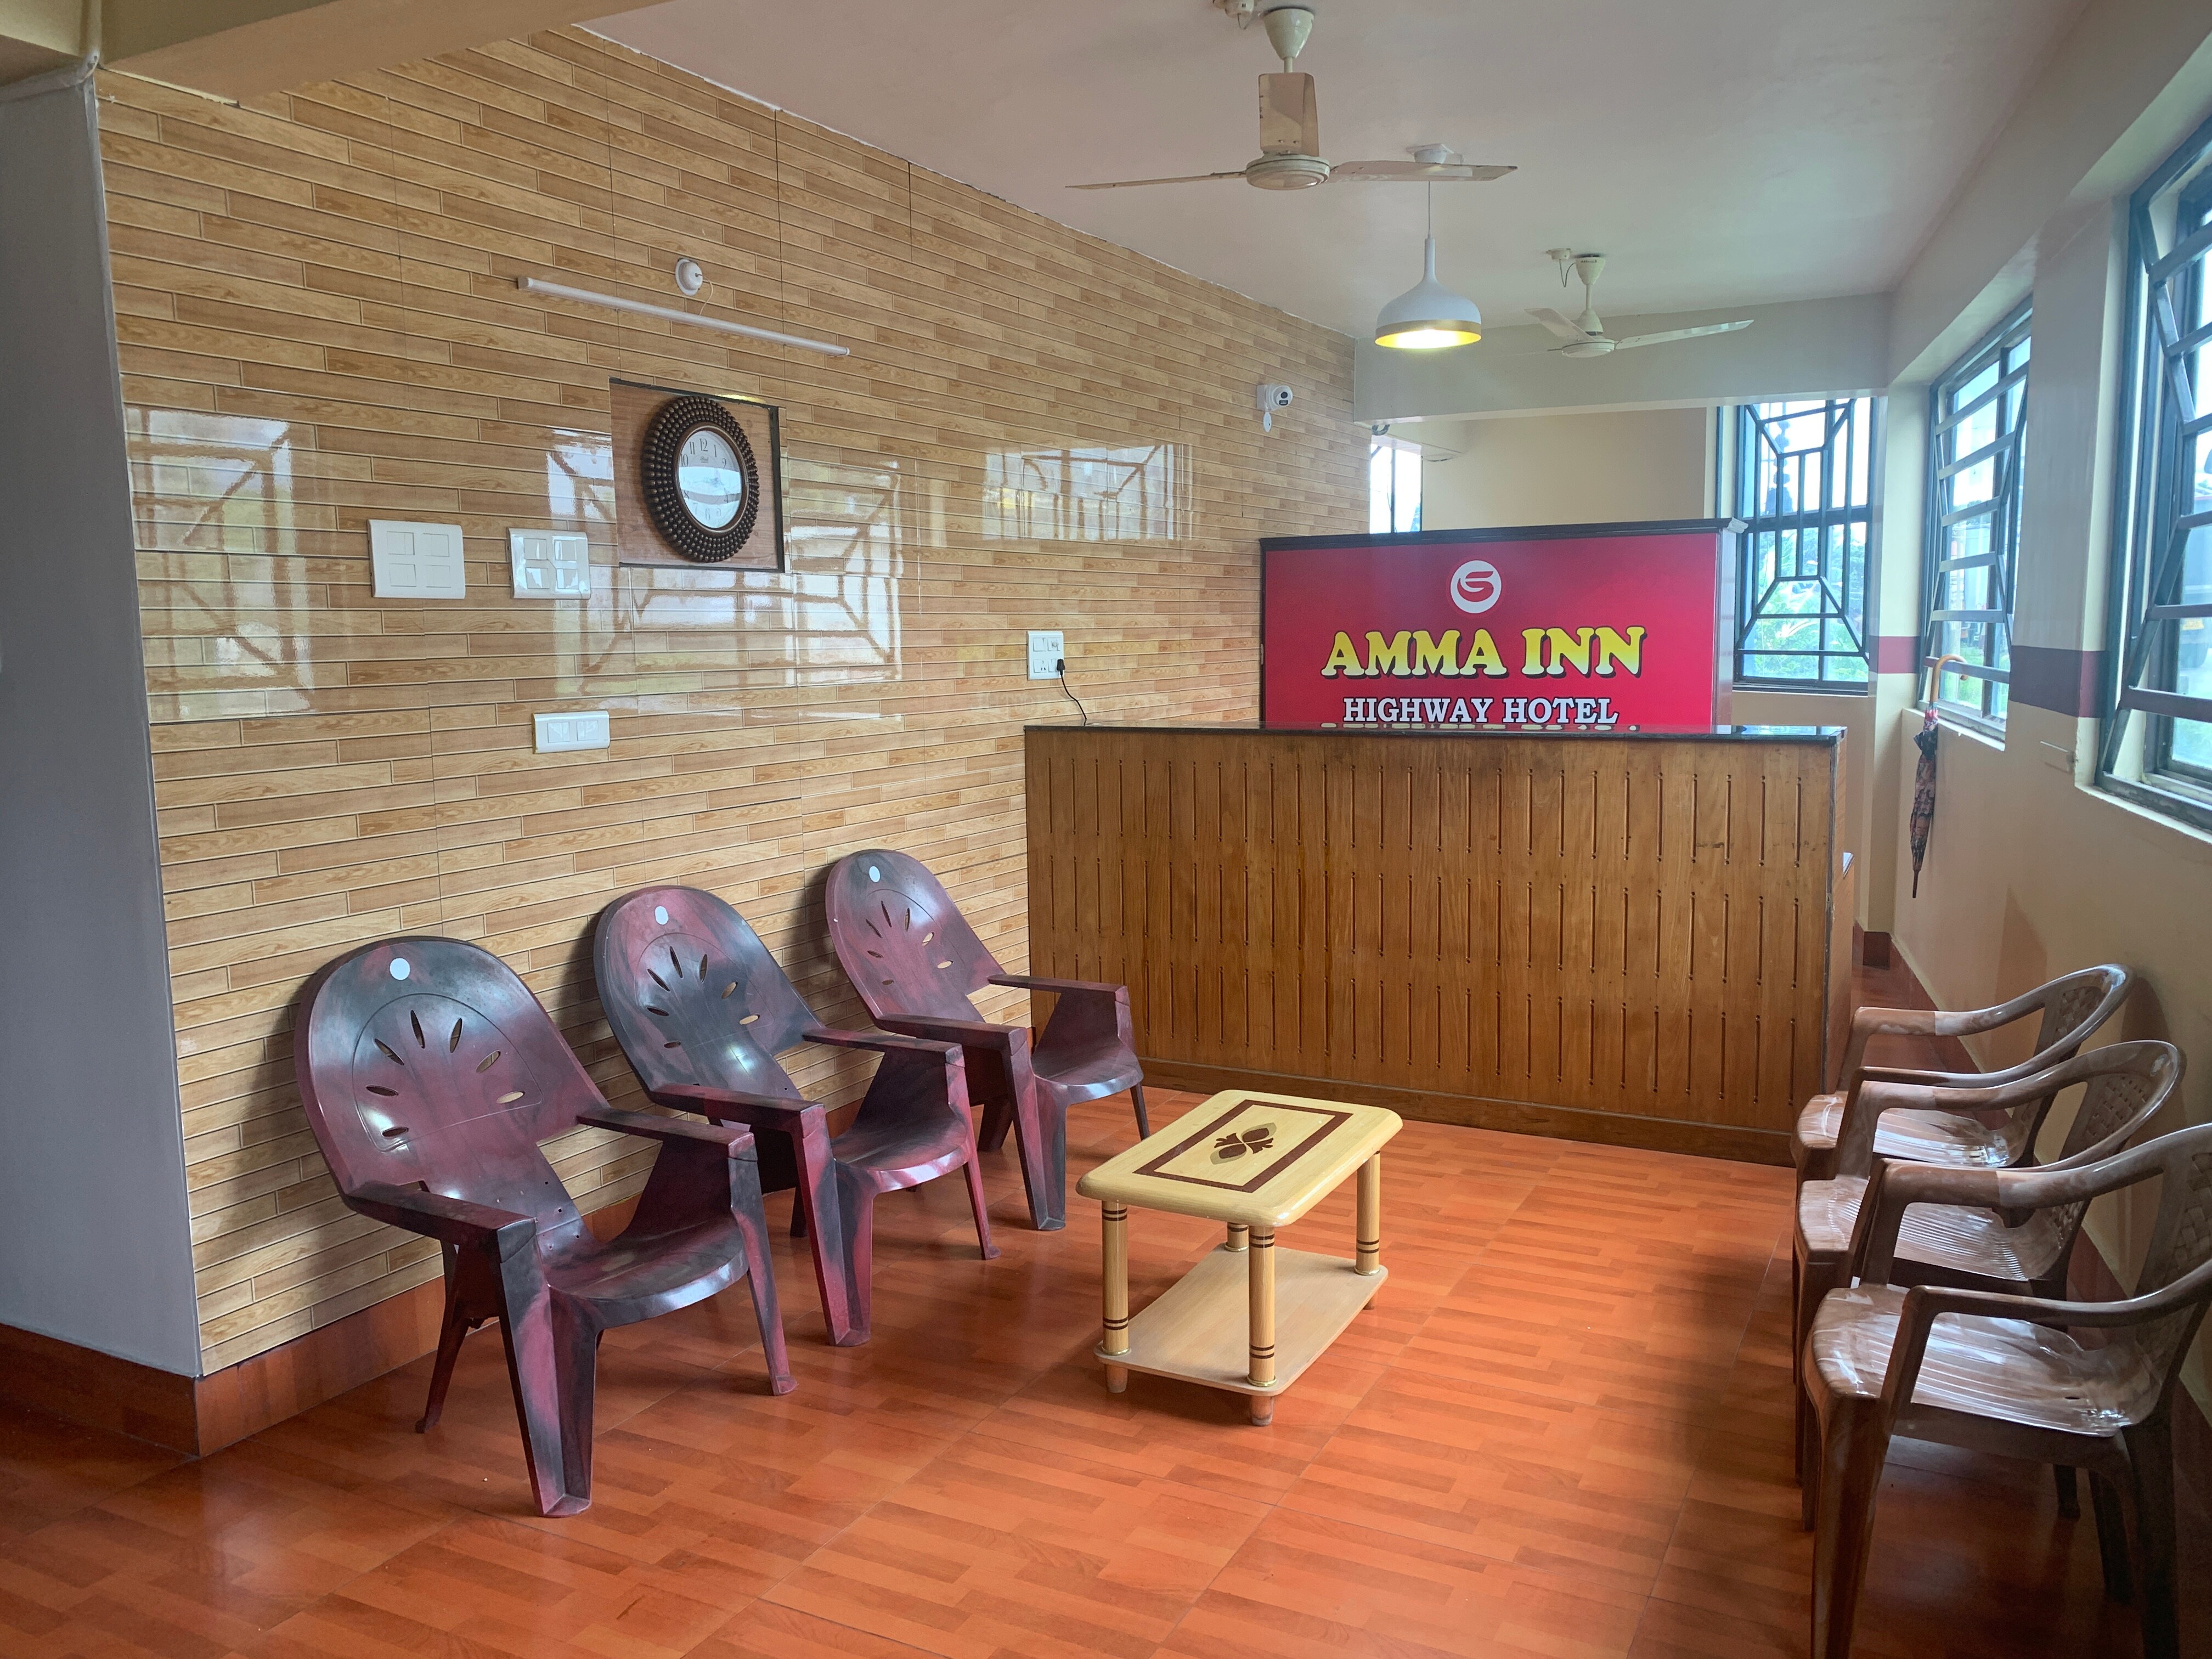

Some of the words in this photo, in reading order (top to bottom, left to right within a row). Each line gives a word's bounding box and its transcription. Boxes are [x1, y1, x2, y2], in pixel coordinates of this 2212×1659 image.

[690, 442, 695, 454] 11
[699, 438, 708, 452] 12
[714, 444, 716, 458] 1
[681, 454, 689, 466] 10
[693, 503, 698, 515] 7
[705, 508, 710, 521] 6
[1321, 629, 1509, 679] AMMA
[1521, 625, 1647, 679] INN
[1343, 697, 1493, 723] HIGHWAY
[1502, 697, 1619, 724] HOTEL
